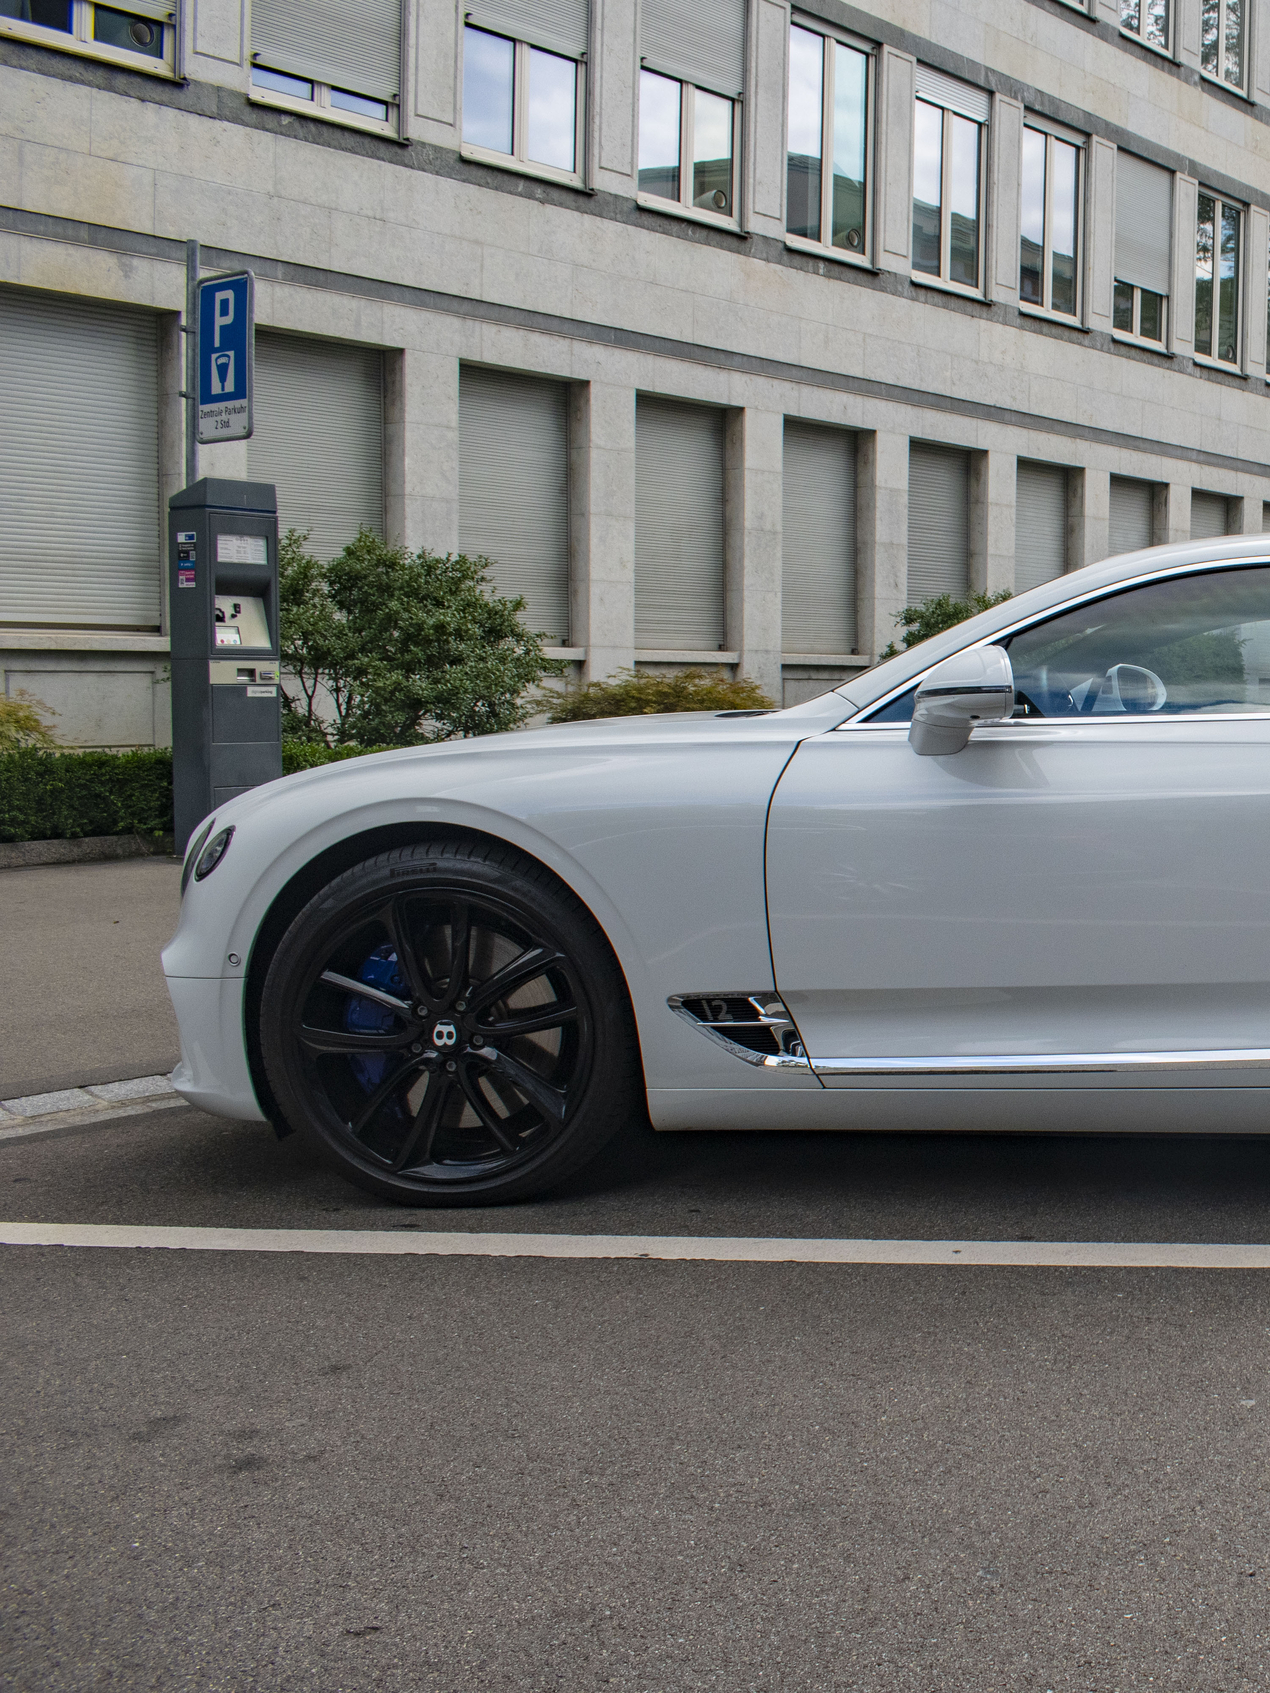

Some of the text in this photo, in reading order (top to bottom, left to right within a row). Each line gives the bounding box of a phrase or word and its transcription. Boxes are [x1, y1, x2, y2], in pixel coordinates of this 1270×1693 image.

[214, 289, 235, 348] P
[200, 404, 247, 419] Zentrale Parkuhr
[215, 418, 231, 430] 2 Std.
[390, 862, 437, 878] PIRELLI
[701, 1000, 733, 1021] 12
[433, 1023, 457, 1047] B
